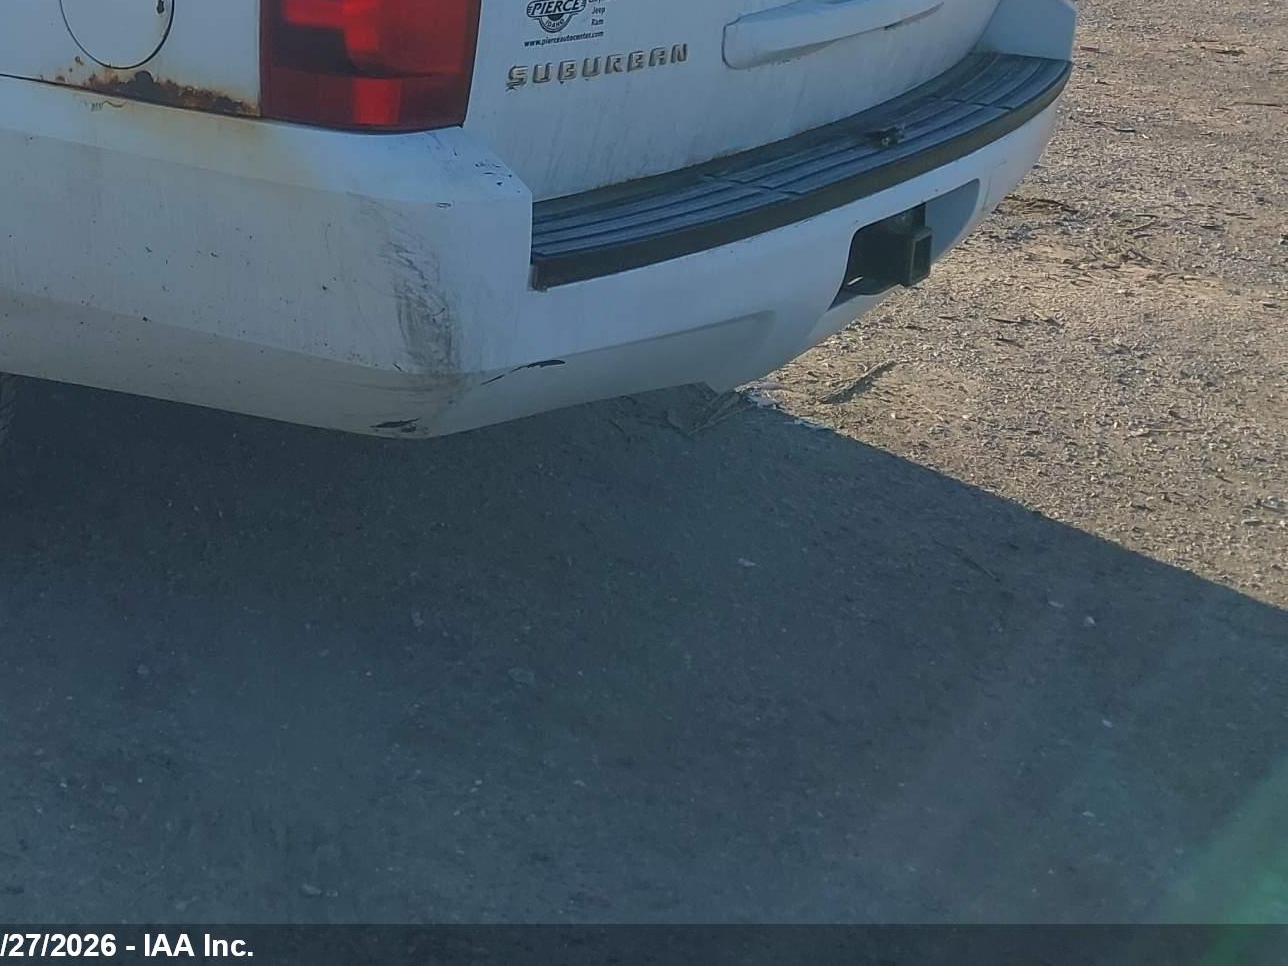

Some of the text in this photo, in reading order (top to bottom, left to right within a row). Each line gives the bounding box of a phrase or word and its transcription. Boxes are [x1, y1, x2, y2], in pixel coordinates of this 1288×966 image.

[592, 7, 606, 15] Jeep
[545, 18, 565, 28] IDAHO
[524, 31, 604, 47] www.pierceautocenter.com
[507, 43, 688, 87] SUBURBAN
